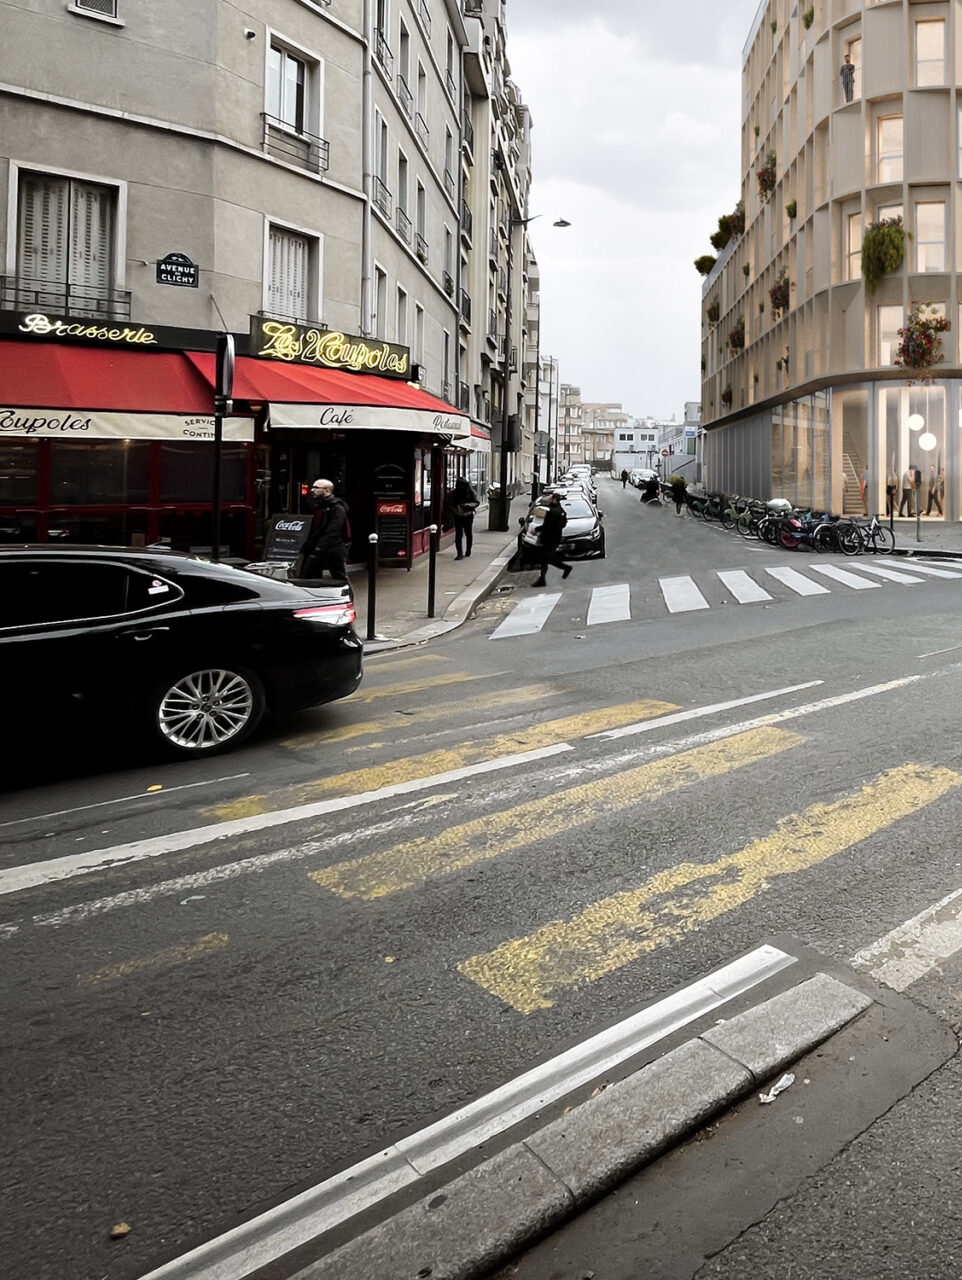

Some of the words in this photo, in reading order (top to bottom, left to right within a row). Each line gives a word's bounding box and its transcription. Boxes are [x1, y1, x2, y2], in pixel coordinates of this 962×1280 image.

[160, 263, 196, 274] AVENUE
[161, 273, 194, 284] CLICHY
[19, 313, 158, 344] Brasserie
[258, 321, 304, 361] Les
[301, 329, 320, 361] 2
[317, 332, 408, 373] Coupoles
[184, 418, 216, 426] SERVIC
[319, 407, 354, 426] Café
